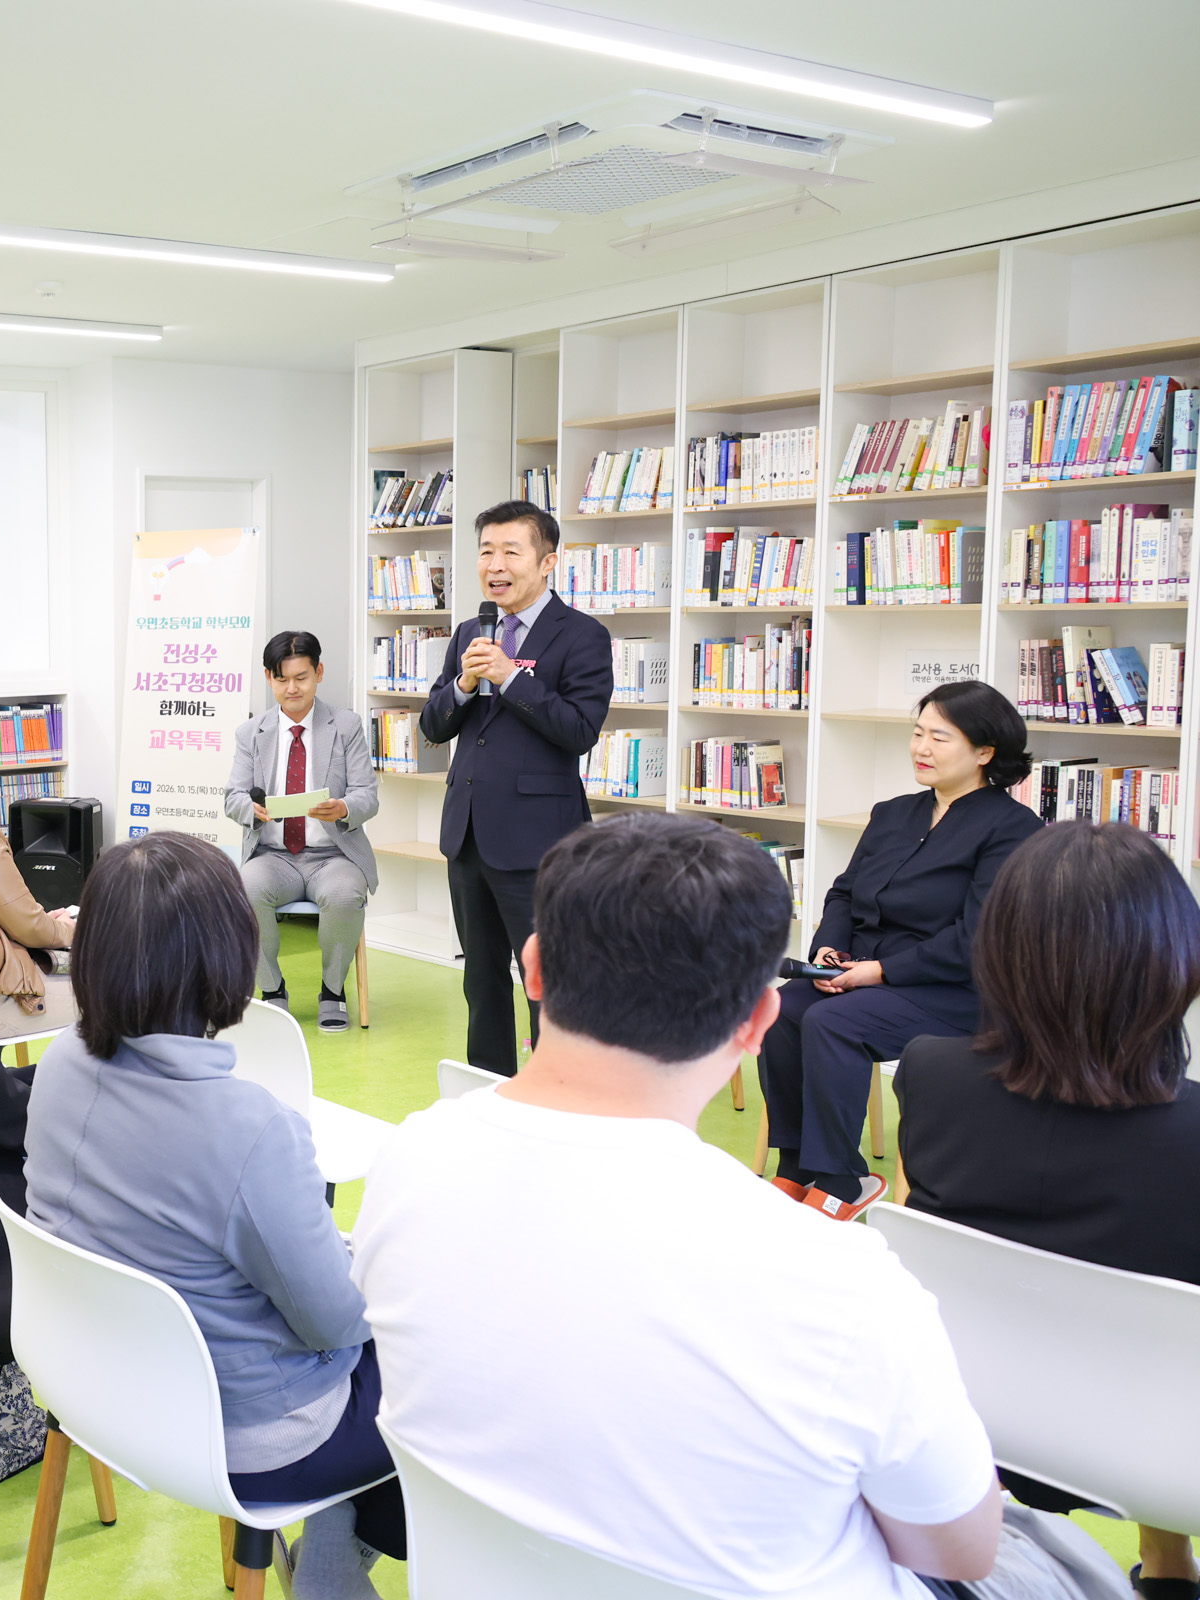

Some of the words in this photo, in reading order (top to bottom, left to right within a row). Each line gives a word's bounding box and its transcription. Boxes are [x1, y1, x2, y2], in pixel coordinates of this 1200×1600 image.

[1141, 539, 1158, 548] 바다
[1141, 549, 1158, 558] 인류
[136, 616, 203, 630] 우면초등학교
[206, 615, 252, 629] 학부모와
[163, 644, 218, 664] 전성수
[911, 663, 942, 676] 교사용
[132, 672, 243, 694] 서초구청장이
[160, 700, 216, 717] 함께하는
[148, 729, 222, 752] 교육톡톡
[134, 782, 149, 792] 일시
[133, 805, 148, 815] 장소
[155, 807, 196, 818] 우면초등학교
[197, 809, 218, 819] 도서실
